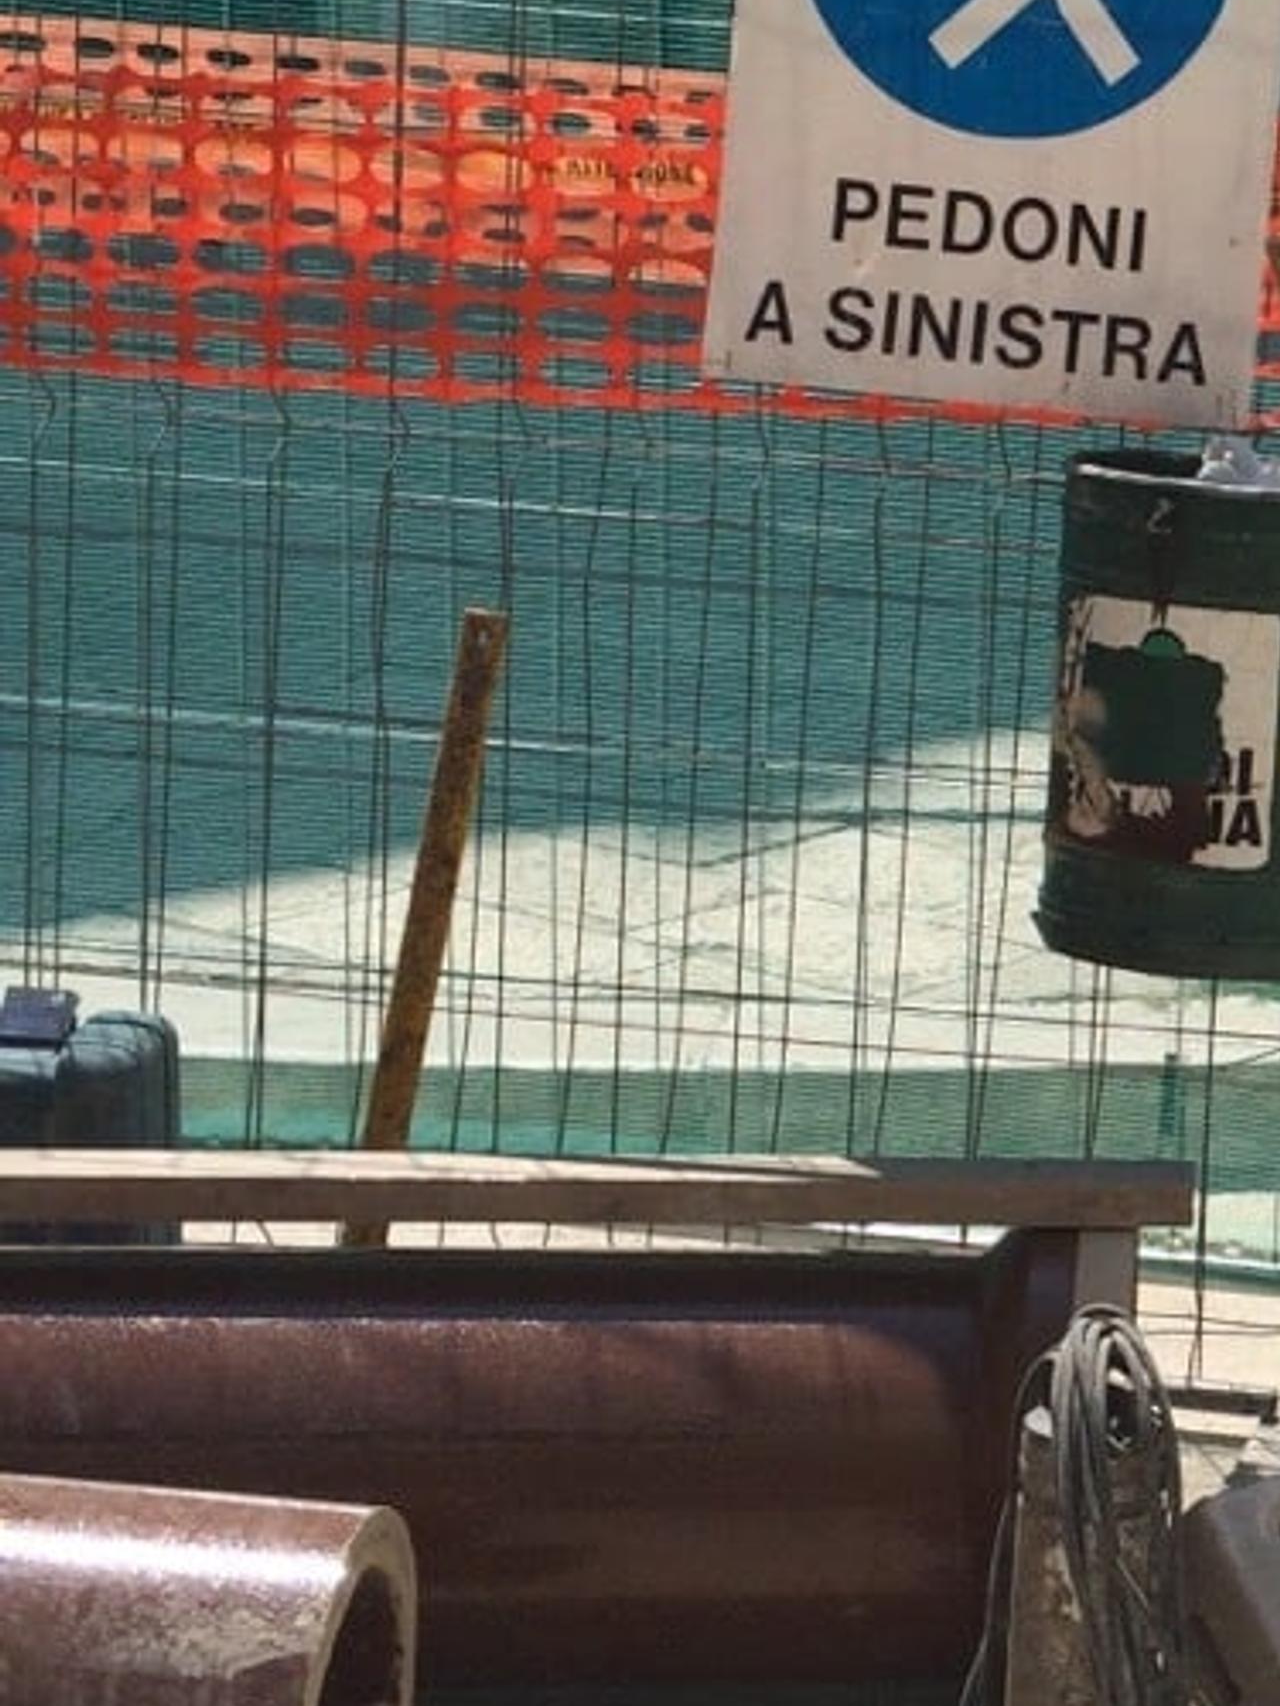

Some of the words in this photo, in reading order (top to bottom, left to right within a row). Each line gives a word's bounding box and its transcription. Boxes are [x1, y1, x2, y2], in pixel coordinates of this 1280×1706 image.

[831, 177, 1147, 273] PEDONI
[744, 281, 794, 345] A
[823, 286, 1207, 386] SINISTRA
